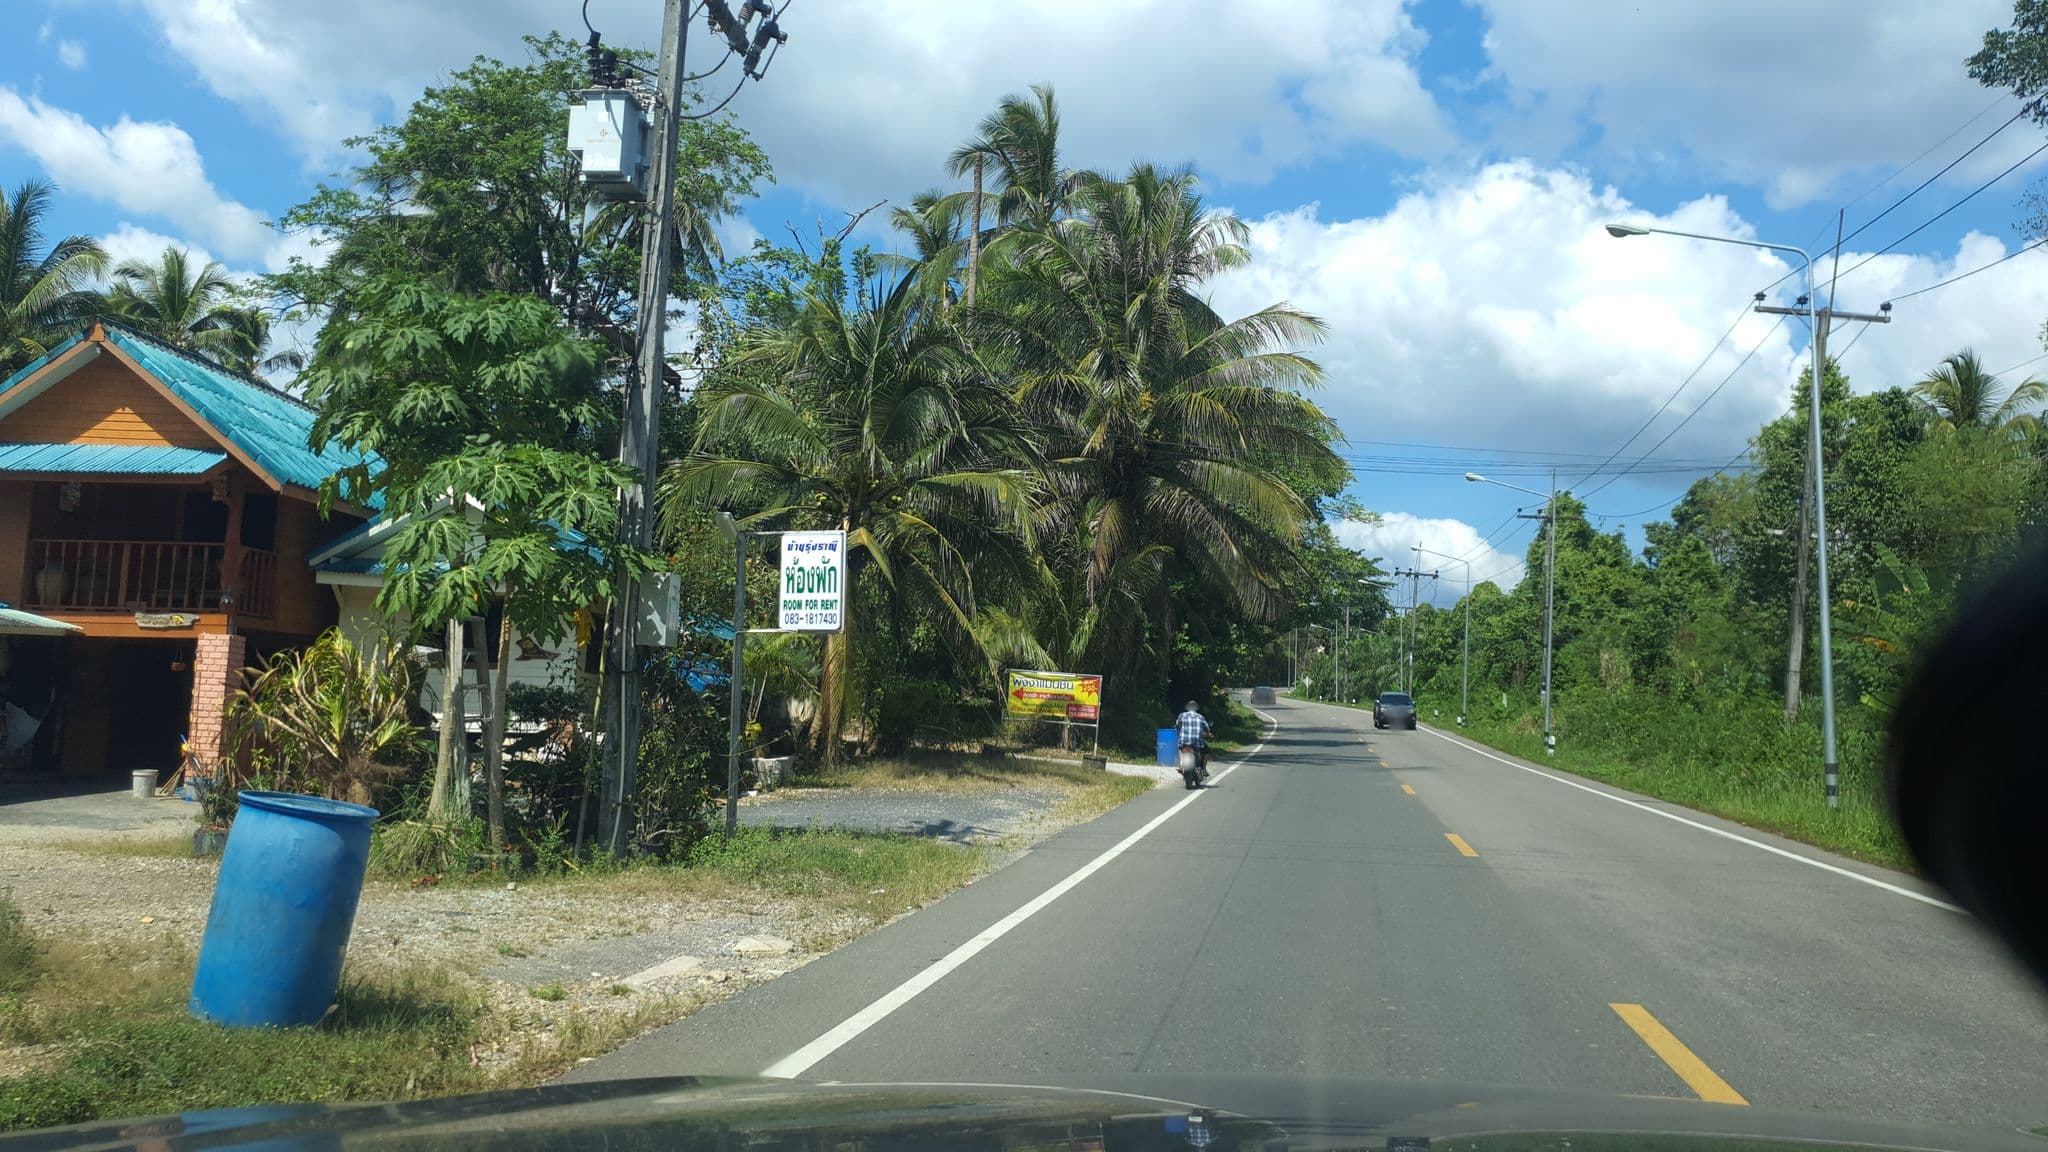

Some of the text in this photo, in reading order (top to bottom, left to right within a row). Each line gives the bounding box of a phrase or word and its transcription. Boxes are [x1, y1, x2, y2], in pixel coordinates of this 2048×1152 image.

[785, 556, 837, 594] ห้องพัก
[783, 599, 838, 611] ROOM FOR RENT
[784, 613, 838, 625] 083-1817430
